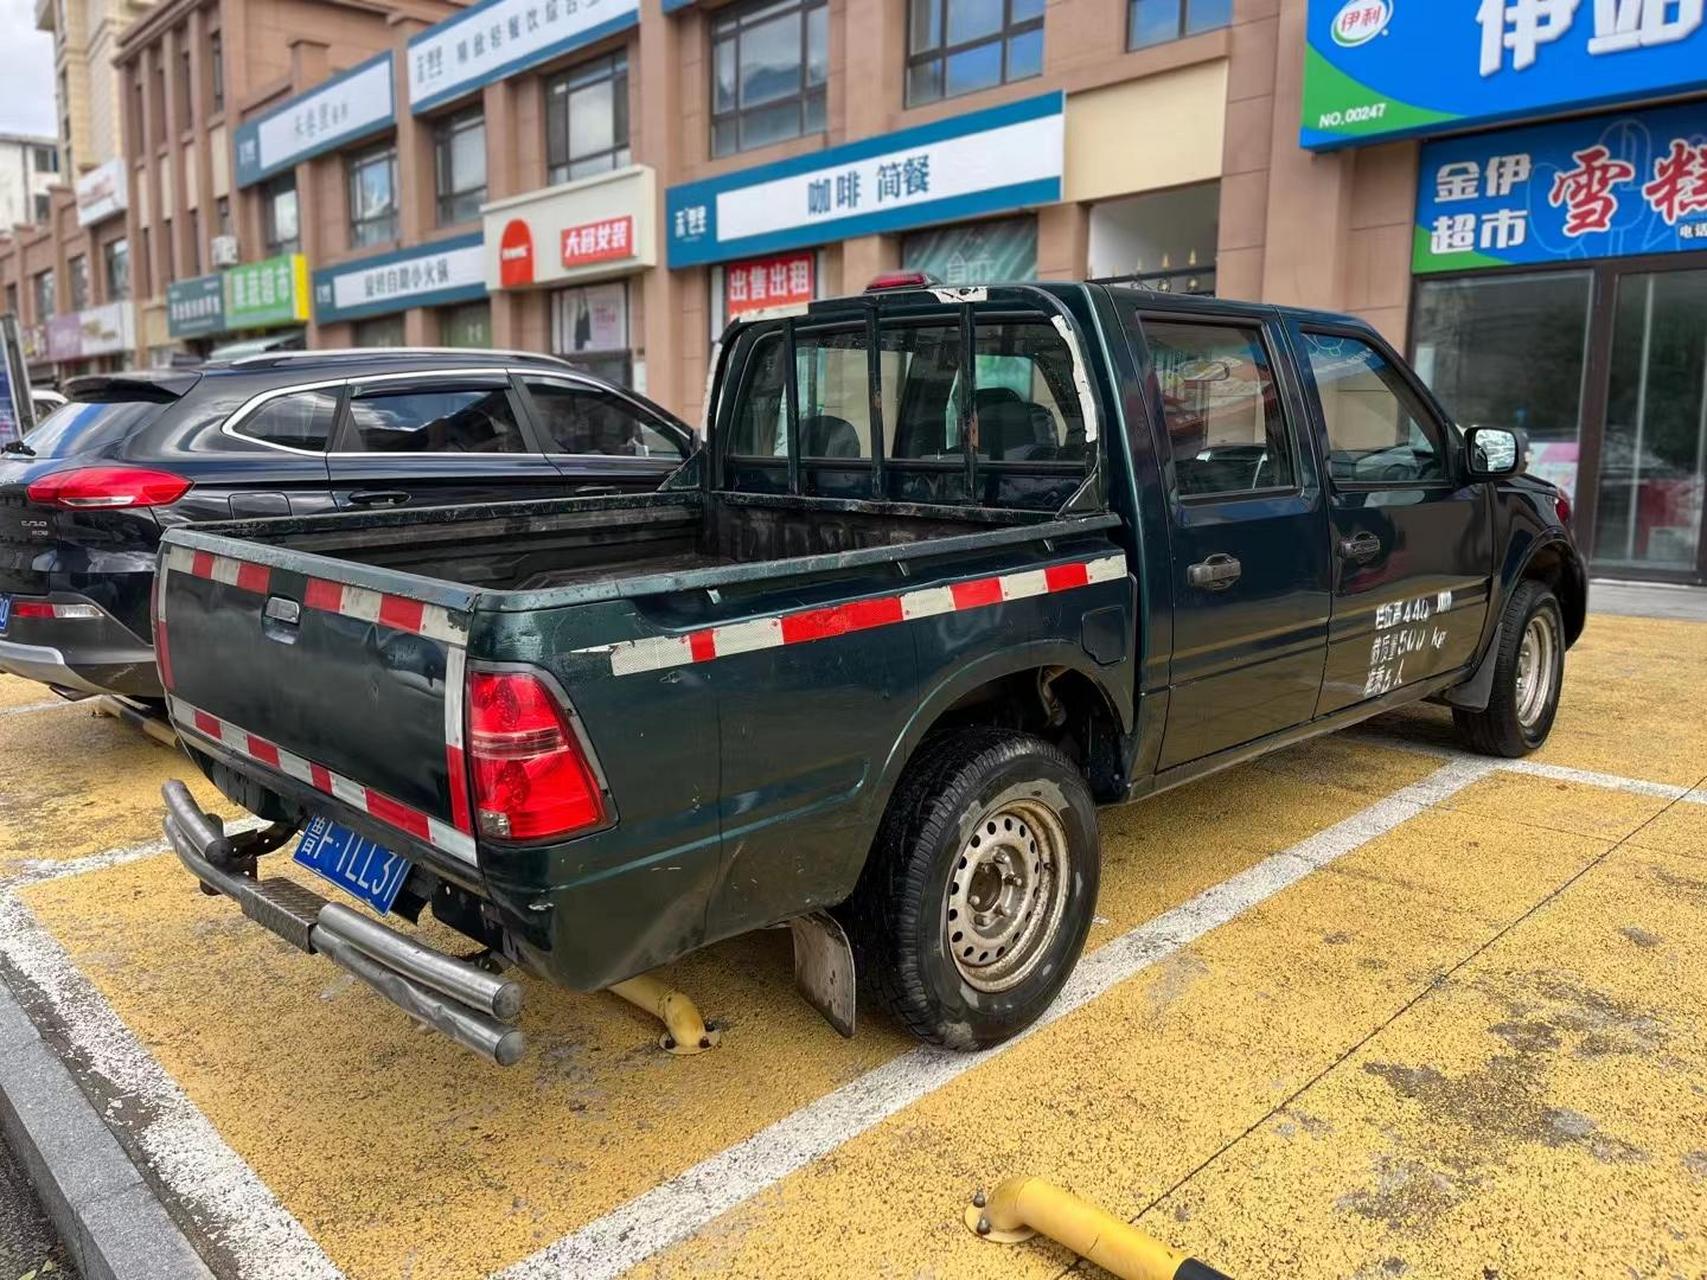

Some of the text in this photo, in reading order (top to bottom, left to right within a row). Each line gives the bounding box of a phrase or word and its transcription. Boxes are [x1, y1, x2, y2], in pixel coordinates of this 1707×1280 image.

[1341, 8, 1381, 31] 伊利
[1319, 104, 1387, 129] NO.00247
[808, 155, 929, 215] 咖啡 简餐
[1434, 153, 1532, 203] 金伊
[564, 221, 628, 259] 大码女装
[1430, 208, 1528, 254] 超市
[730, 261, 809, 300] 出售出租
